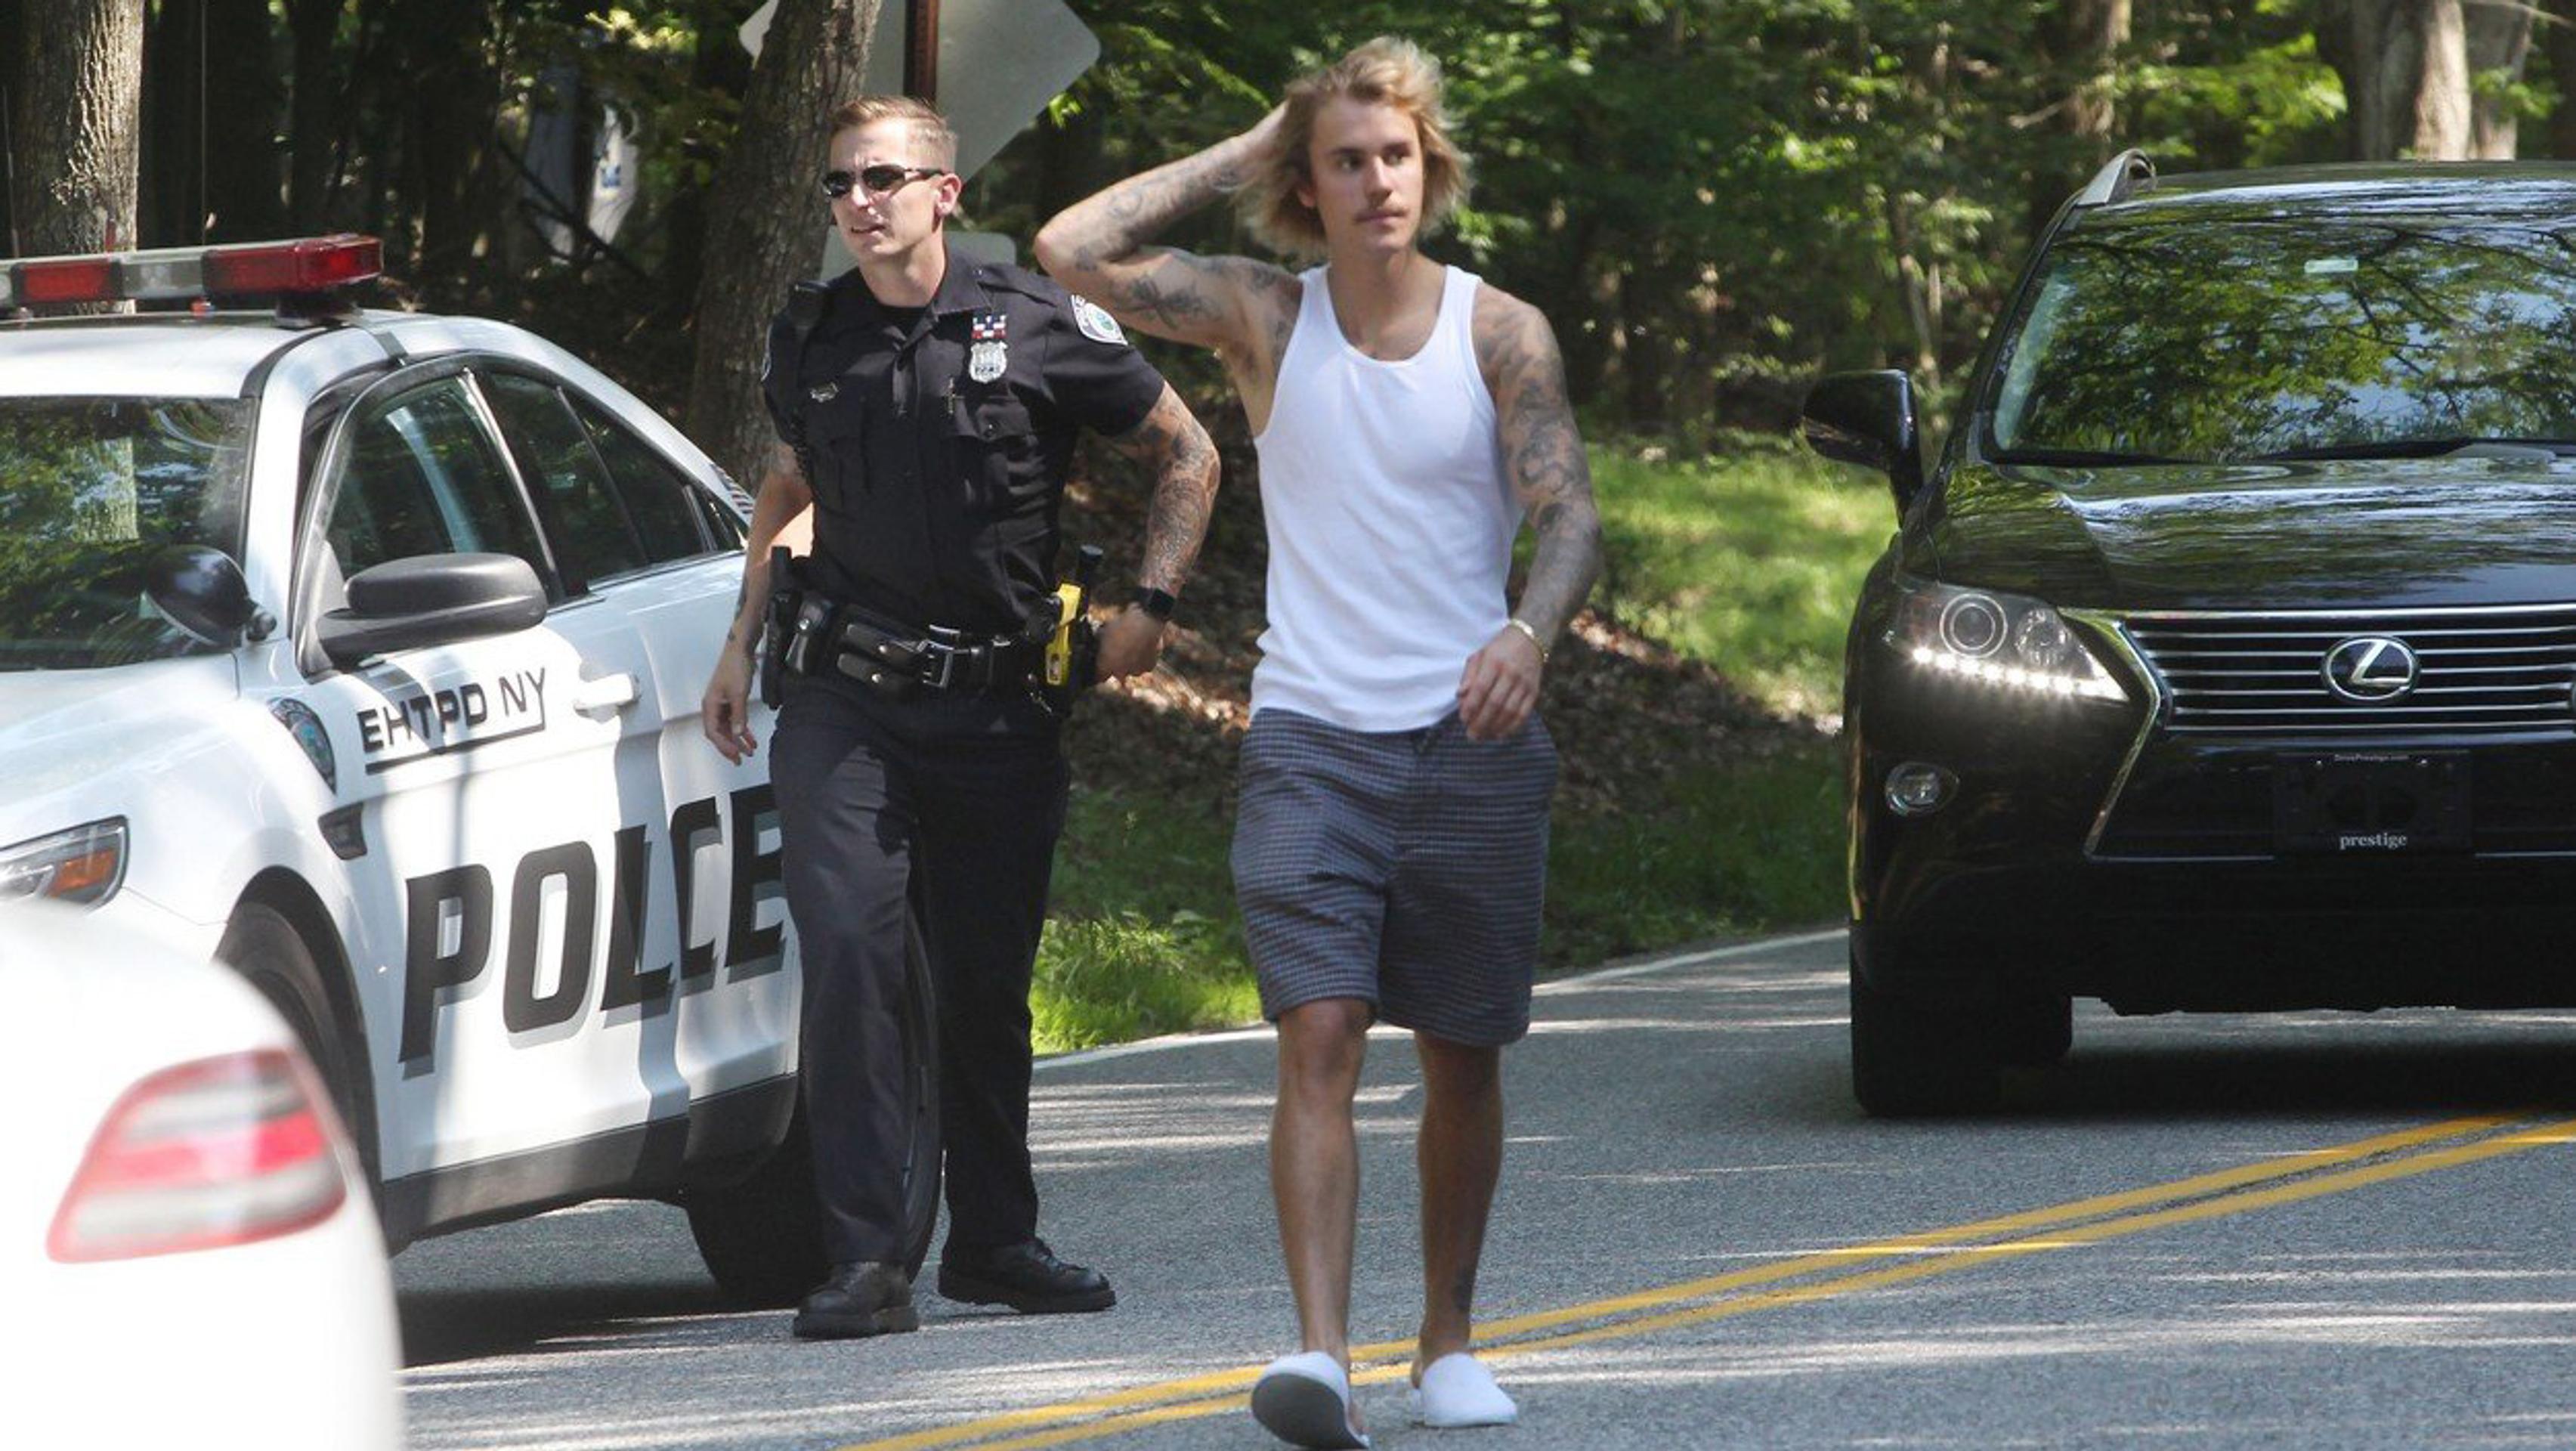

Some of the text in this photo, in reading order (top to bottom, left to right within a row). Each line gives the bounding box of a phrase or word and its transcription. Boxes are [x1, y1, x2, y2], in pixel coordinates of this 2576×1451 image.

[357, 682, 488, 754] EHTPD
[498, 667, 546, 729] NY
[2339, 832, 2407, 850] prestige
